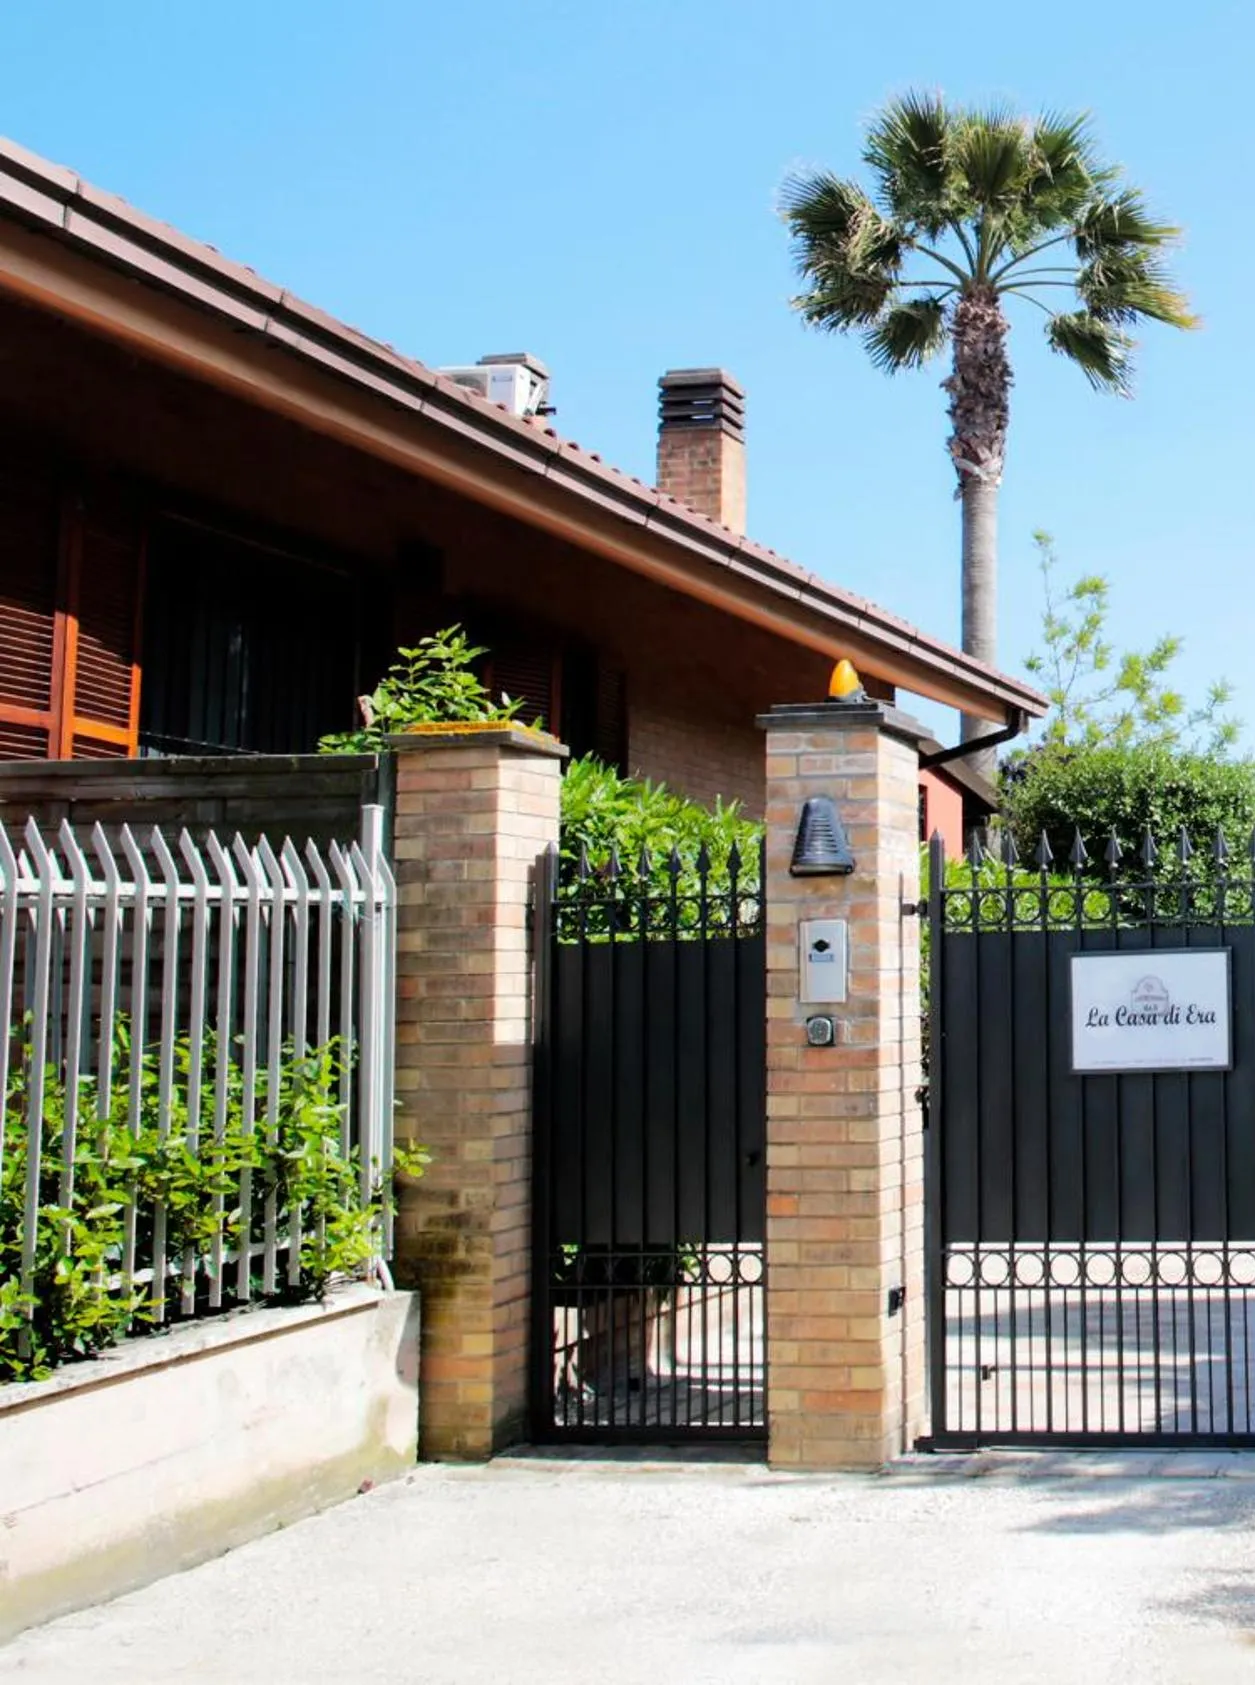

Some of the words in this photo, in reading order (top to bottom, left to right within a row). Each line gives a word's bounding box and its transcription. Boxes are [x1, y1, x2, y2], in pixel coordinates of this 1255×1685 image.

[1085, 1007, 1109, 1027] La
[1115, 1005, 1157, 1026] Casa
[1164, 1004, 1180, 1025] di
[1186, 1003, 1216, 1025] Era
